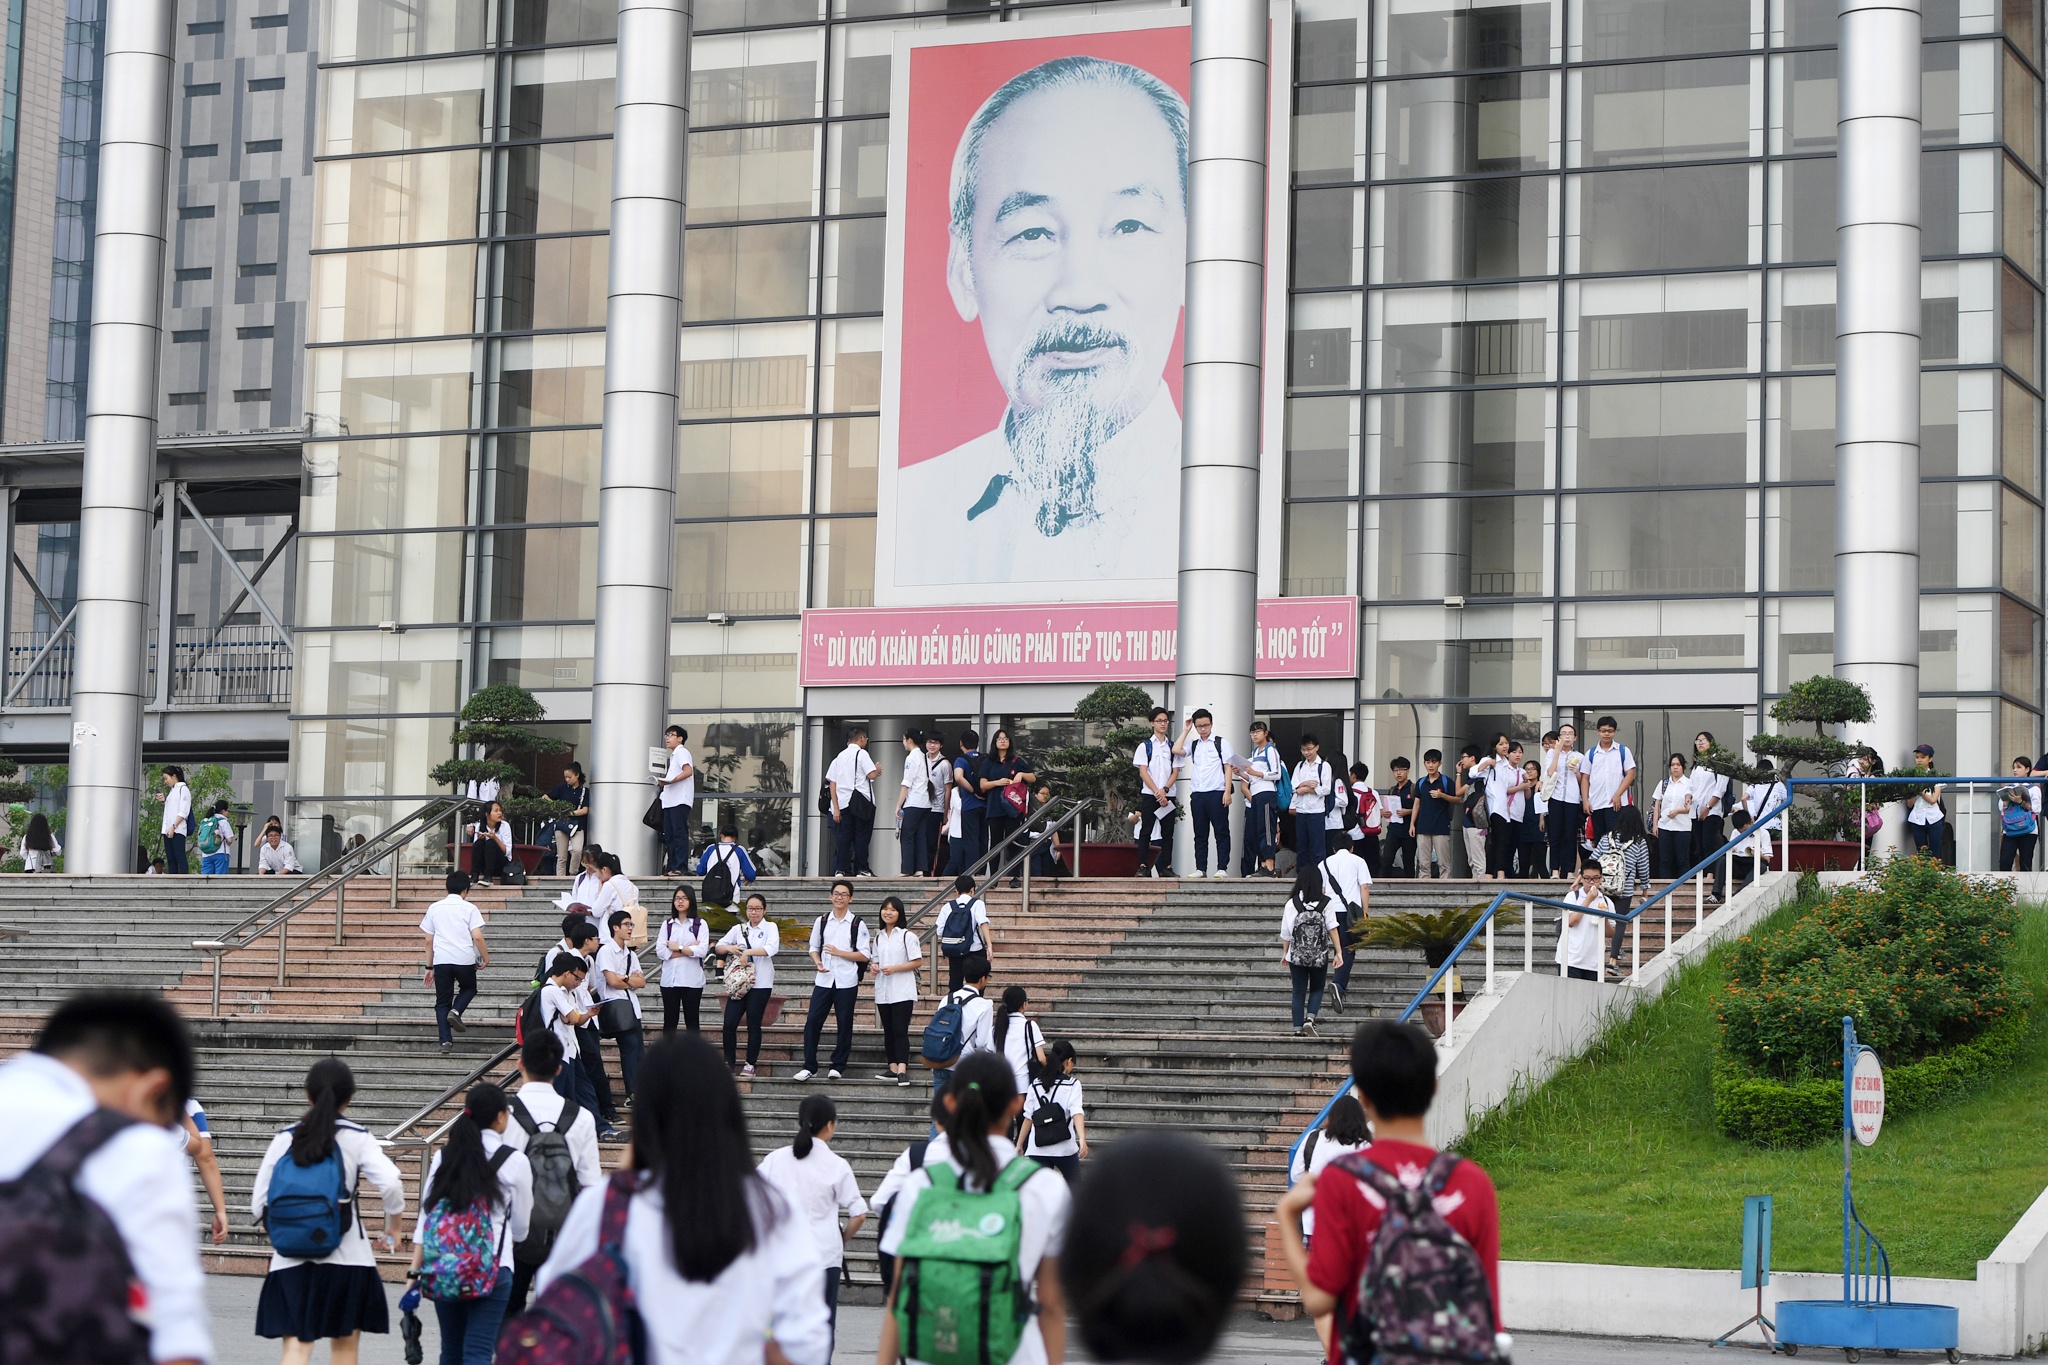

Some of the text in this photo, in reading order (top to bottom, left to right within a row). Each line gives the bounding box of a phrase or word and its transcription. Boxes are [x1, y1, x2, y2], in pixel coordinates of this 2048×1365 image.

[850, 630, 877, 666] KHÓ
[880, 629, 918, 666] KHĂN
[920, 624, 948, 665] ĐẾN
[952, 628, 980, 665] ĐÂU
[983, 627, 1022, 664] CŨNG
[1025, 619, 1058, 663] PHẢI
[1062, 620, 1092, 662] TIẾP
[1096, 630, 1122, 669] TỤC
[1126, 630, 1148, 662] THI
[1151, 629, 1177, 661] ĐUA
[1255, 621, 1264, 659] À
[1268, 627, 1297, 666] HỌC
[1651, 650, 1675, 659] EXIT
[556, 669, 575, 678] EXIT
